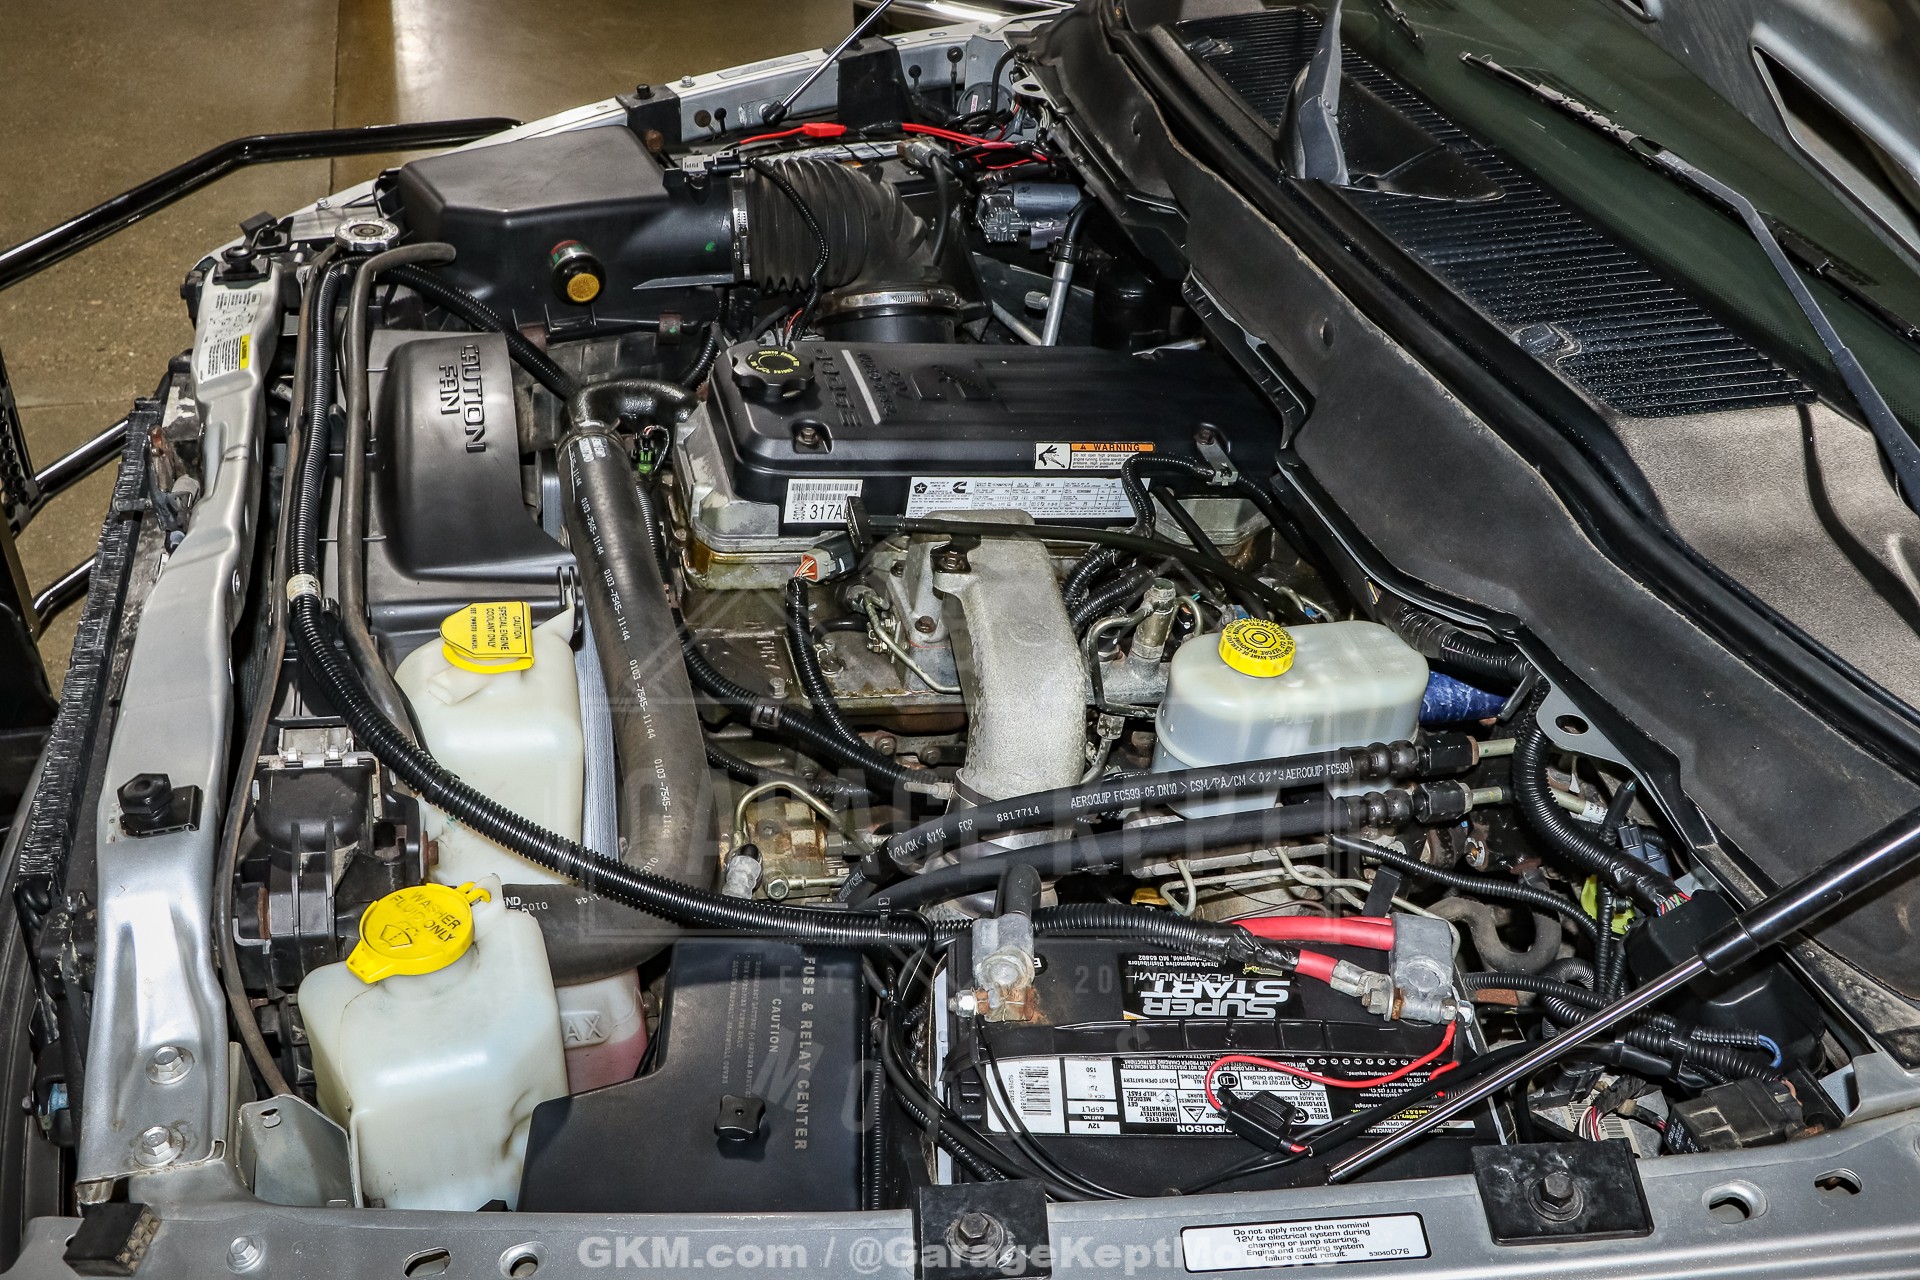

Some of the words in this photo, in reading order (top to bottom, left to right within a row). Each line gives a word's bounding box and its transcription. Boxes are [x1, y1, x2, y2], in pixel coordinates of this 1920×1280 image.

[440, 365, 460, 415] FAN
[461, 345, 487, 454] CAUTION
[1094, 444, 1140, 452] WARNING
[810, 504, 850, 520] 317A
[580, 498, 590, 513] 0103
[592, 536, 604, 556] 11:44
[604, 568, 615, 587] 0103
[608, 588, 621, 615] -7545-
[486, 608, 496, 632] COOLANT
[513, 615, 523, 640] CAUTION
[616, 616, 630, 641] 11:44
[488, 634, 496, 648] ONLY
[500, 629, 510, 650] ENGINE
[629, 660, 641, 681] 0103
[634, 682, 647, 712] -7545-
[642, 714, 656, 740] 11:44
[654, 758, 666, 780] 0103
[660, 782, 670, 812] -7545-
[1070, 792, 1112, 809] AEROQUIP
[1114, 787, 1155, 802] FC599-06
[1158, 784, 1177, 797] DN10
[1190, 774, 1246, 792] CSM/PA/CM
[1286, 766, 1324, 780] AEROQUIP
[958, 818, 974, 834] FCP
[996, 805, 1040, 822] 8817714
[390, 894, 426, 922] FLUID
[424, 919, 456, 942] ONLY
[410, 891, 461, 930] WASHER
[802, 957, 816, 995] FUSE
[1200, 960, 1218, 968] Ozark
[1126, 971, 1234, 984] PLATINUM+
[1140, 980, 1290, 1003] START
[801, 1002, 814, 1012] &
[1142, 998, 1276, 1019] SUPER
[564, 1015, 604, 1044] AX
[768, 998, 782, 1053] CAUTION
[798, 1020, 813, 1072] RELAY
[795, 1080, 810, 1150] CENTER
[1236, 1235, 1254, 1243] 12V
[1256, 1234, 1266, 1242] to
[1269, 1232, 1307, 1241] electrical
[1310, 1230, 1340, 1240] system
[1343, 1228, 1370, 1237] during
[1248, 1240, 1286, 1250] charging
[1299, 1238, 1321, 1247] jump
[1323, 1236, 1360, 1246] starting.
[1265, 1226, 1287, 1235] apply
[1246, 1248, 1275, 1257] Engine
[1296, 1245, 1330, 1254] starting
[1333, 1243, 1364, 1251] system
[1265, 1254, 1292, 1262] failure
[1294, 1252, 1318, 1260] could
[1369, 1248, 1410, 1256] 53040076
